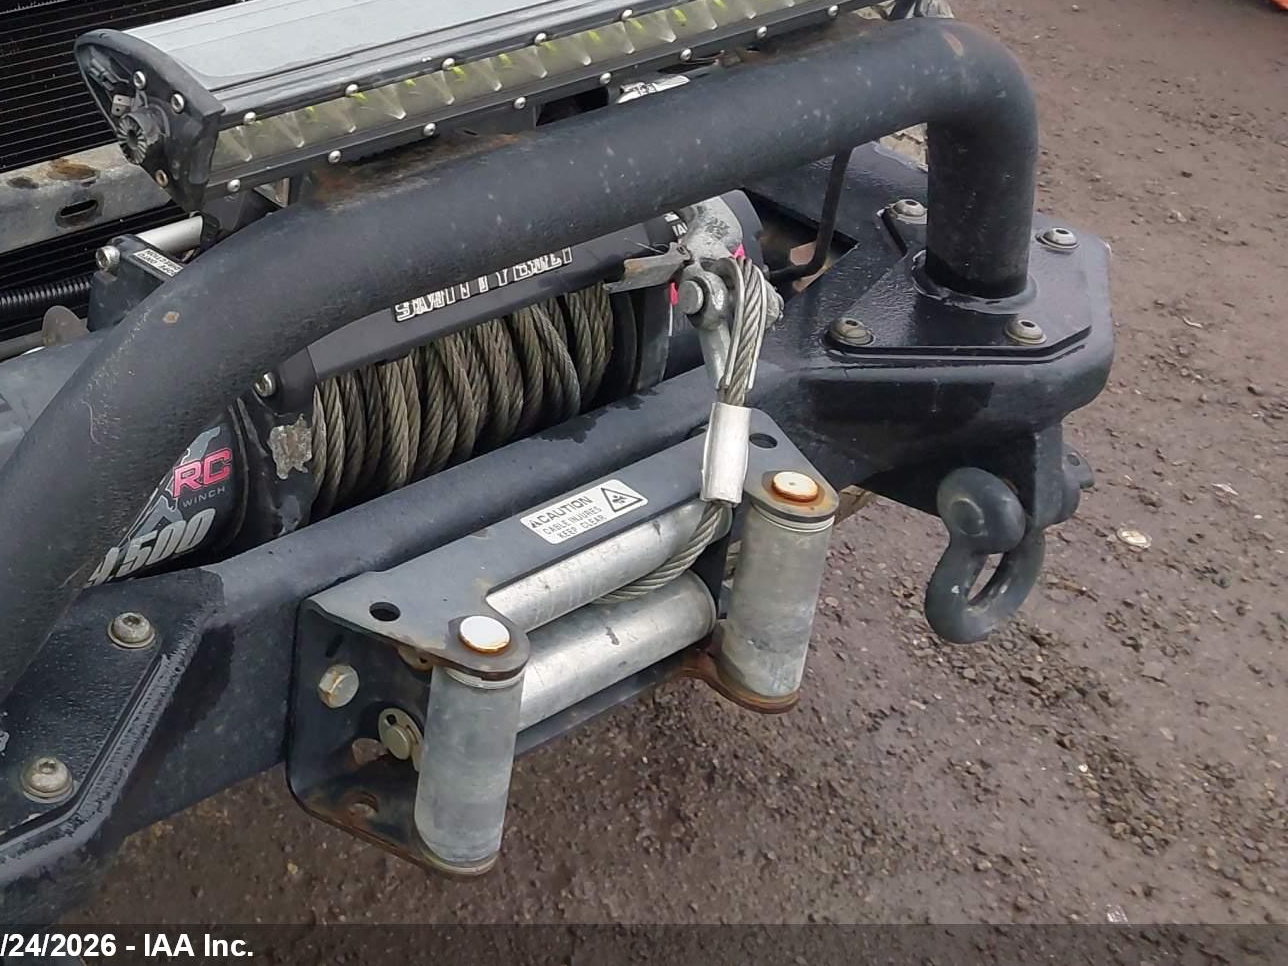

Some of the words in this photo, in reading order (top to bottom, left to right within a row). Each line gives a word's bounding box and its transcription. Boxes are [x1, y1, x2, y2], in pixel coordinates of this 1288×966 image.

[182, 487, 226, 508] WINCH
[542, 519, 570, 535] CABLE
[558, 528, 579, 539] KEEP
